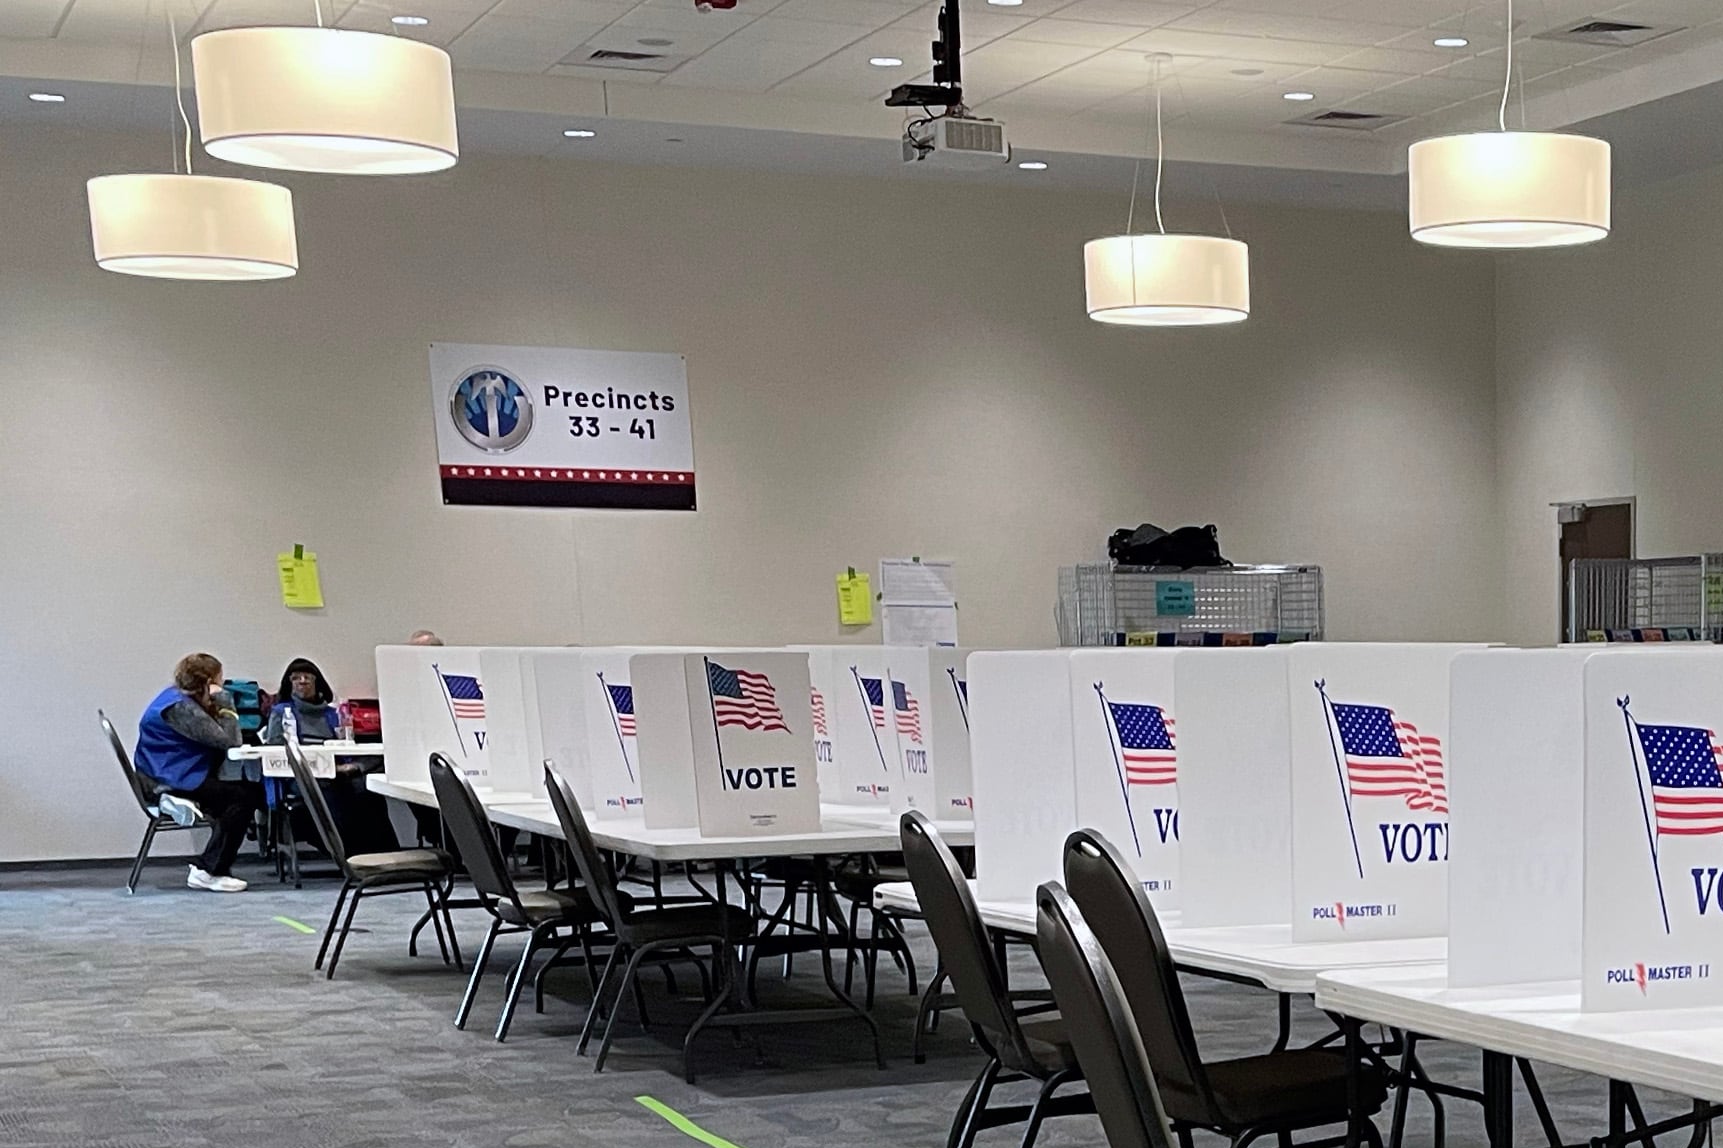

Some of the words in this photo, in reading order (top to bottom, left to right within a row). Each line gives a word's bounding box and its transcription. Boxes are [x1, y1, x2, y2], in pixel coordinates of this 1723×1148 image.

[543, 385, 675, 411] Precincts
[569, 416, 600, 438] 33
[629, 418, 656, 439] 41
[906, 749, 928, 774] VOTE
[726, 767, 797, 790] VOTE
[1379, 822, 1449, 863] VOT
[1313, 907, 1336, 919] POLL
[1346, 905, 1382, 917] MASTER
[1607, 969, 1635, 983] POLL
[1648, 966, 1692, 981] MASTER
[1699, 964, 1710, 978] II
